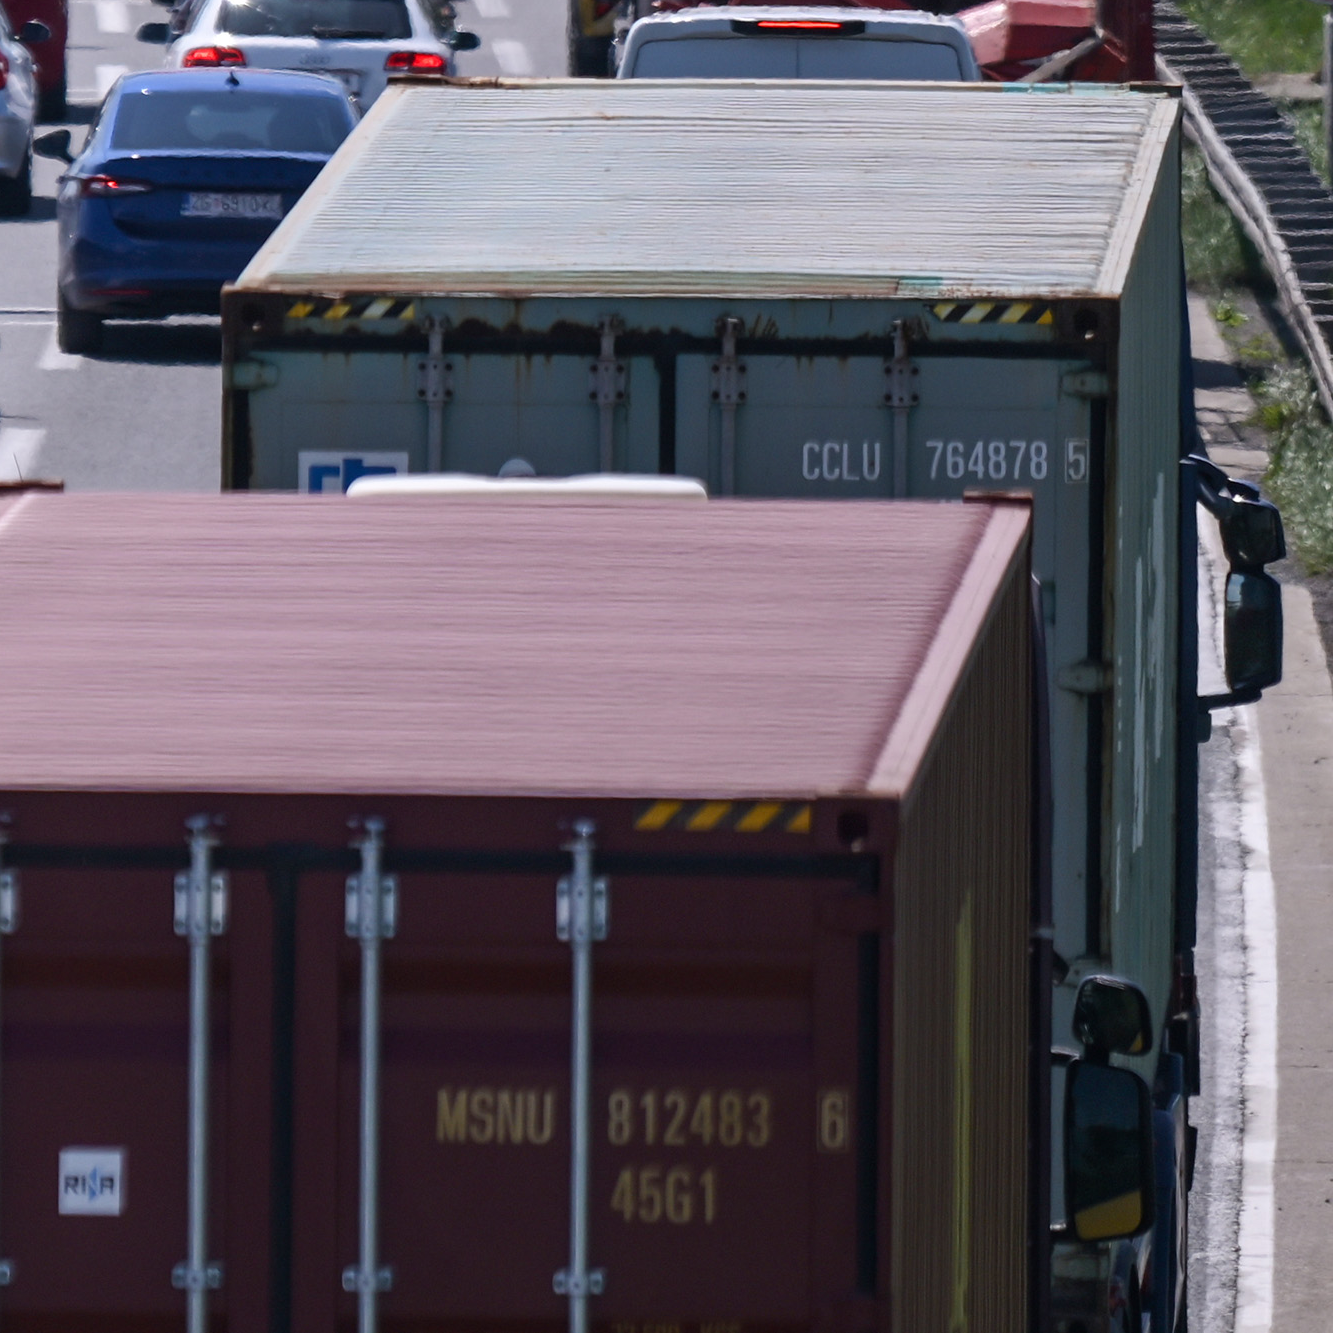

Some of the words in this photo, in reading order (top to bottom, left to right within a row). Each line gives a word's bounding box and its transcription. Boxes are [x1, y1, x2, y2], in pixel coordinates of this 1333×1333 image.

[801, 441, 881, 481] CCLU
[926, 440, 1048, 481] 764878
[1067, 441, 1086, 481] 5
[434, 1086, 556, 1146] MSNU
[606, 1088, 773, 1148] 812483
[821, 1090, 846, 1150] 6
[610, 1166, 717, 1226] 45G1
